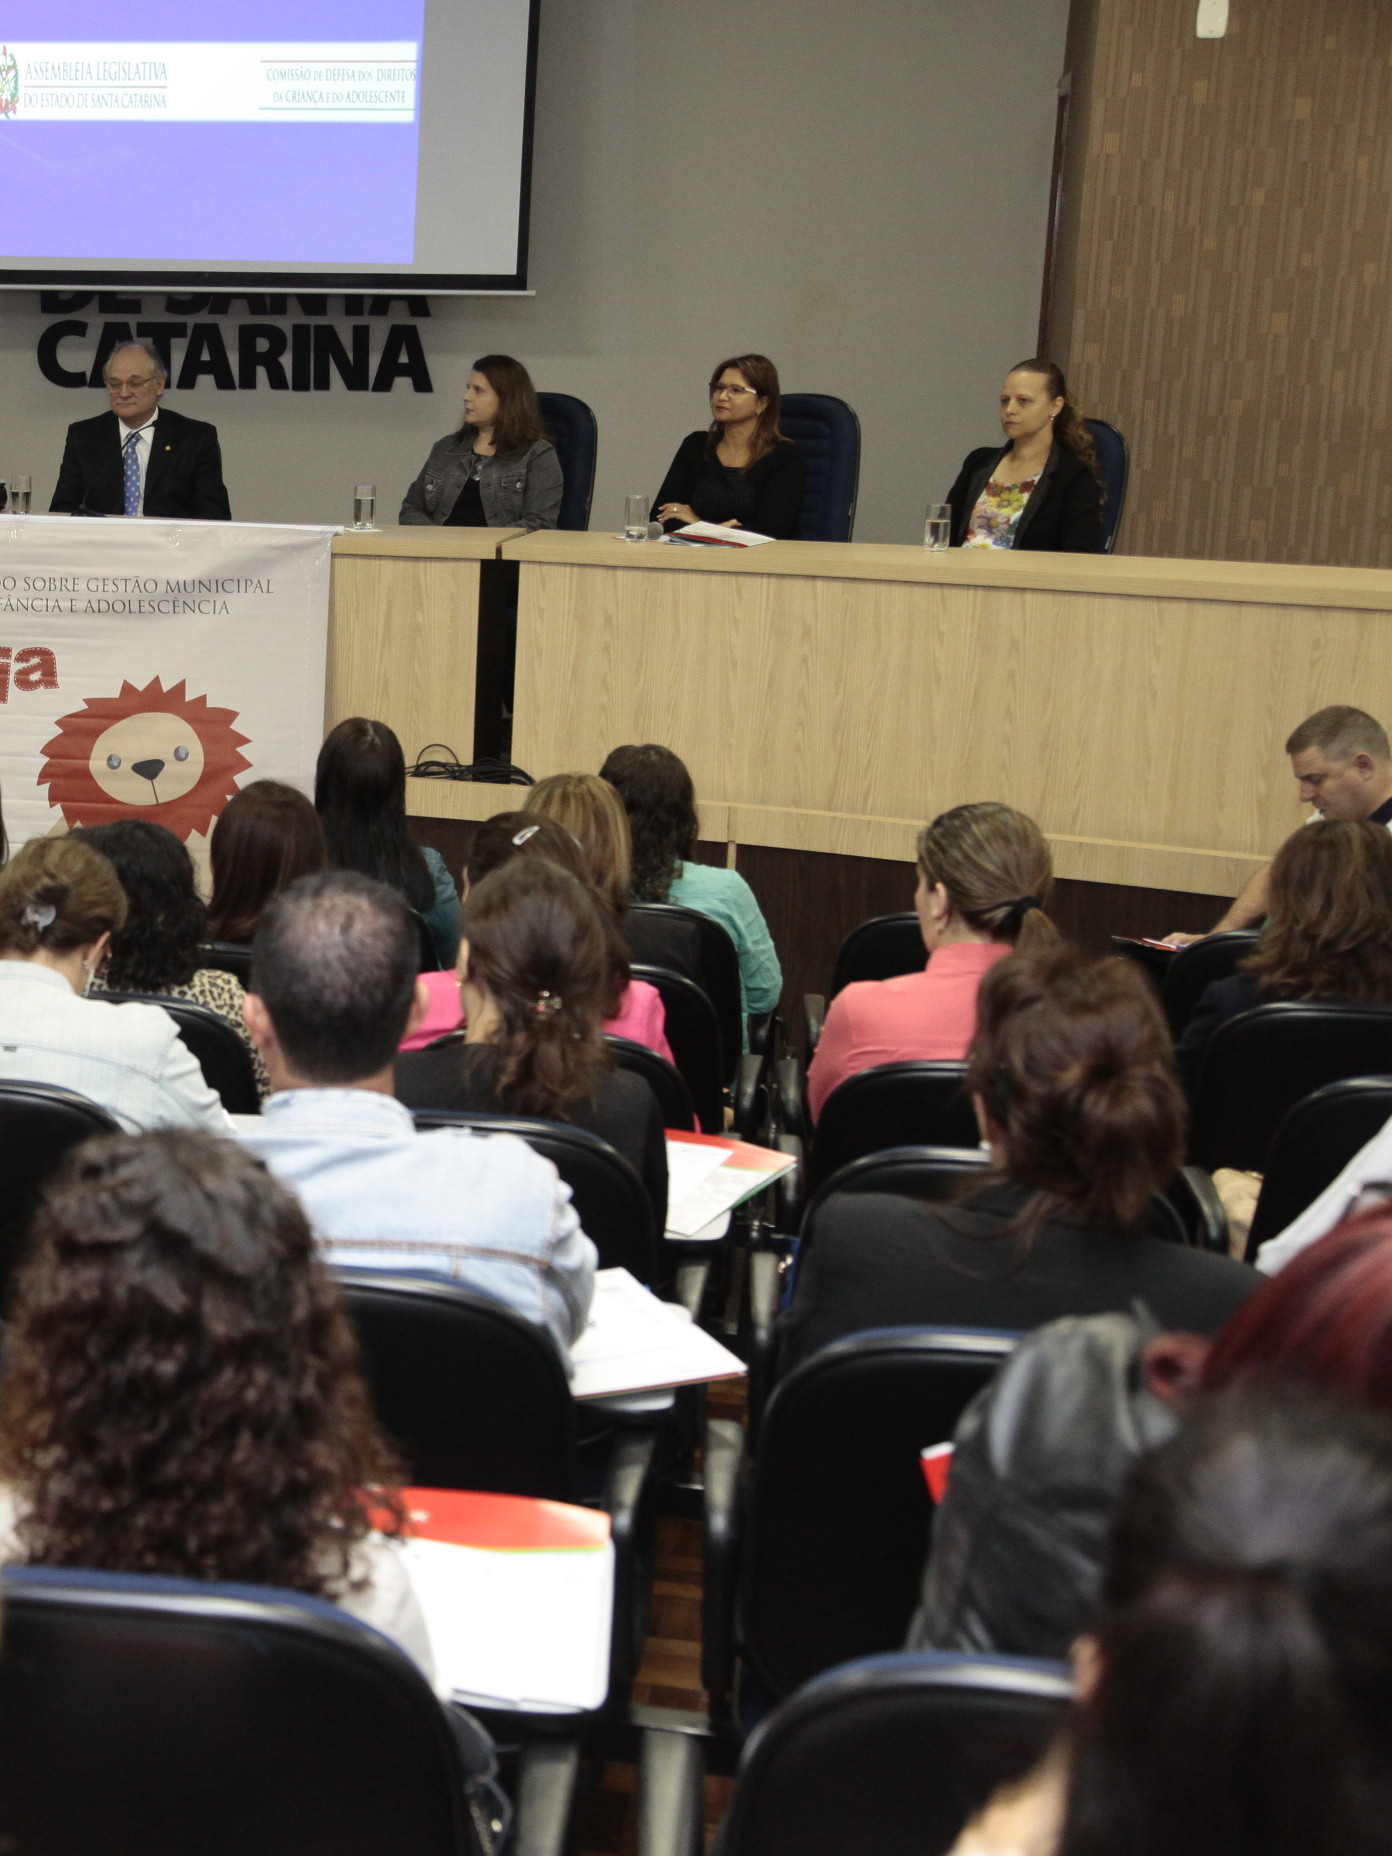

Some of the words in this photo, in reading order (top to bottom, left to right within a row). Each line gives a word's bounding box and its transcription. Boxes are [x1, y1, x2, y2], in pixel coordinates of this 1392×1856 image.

[25, 61, 93, 81] ASSEMBLEIA
[96, 62, 168, 82] LEGISLATIVA
[266, 66, 311, 81] COMISSÃO
[314, 70, 322, 81] DE
[325, 68, 356, 82] DEFESA
[358, 70, 373, 82] DOS
[377, 68, 416, 82] DIREITOS
[24, 93, 38, 108] DO
[41, 93, 75, 108] ESTADO
[77, 93, 88, 108] DE
[91, 93, 120, 108] SANTA
[121, 93, 167, 109] CATARINA
[285, 90, 323, 106] CRIANÇA
[332, 92, 343, 103] DO
[345, 90, 406, 103] ADOLESCENTE
[36, 319, 434, 393] CATARINA
[23, 576, 80, 593] SOBRE
[86, 575, 158, 594] GESTÃO
[165, 578, 274, 594] MUNICIPAL
[70, 598, 78, 613] E
[84, 596, 231, 615] ADOLESCÊNCIA
